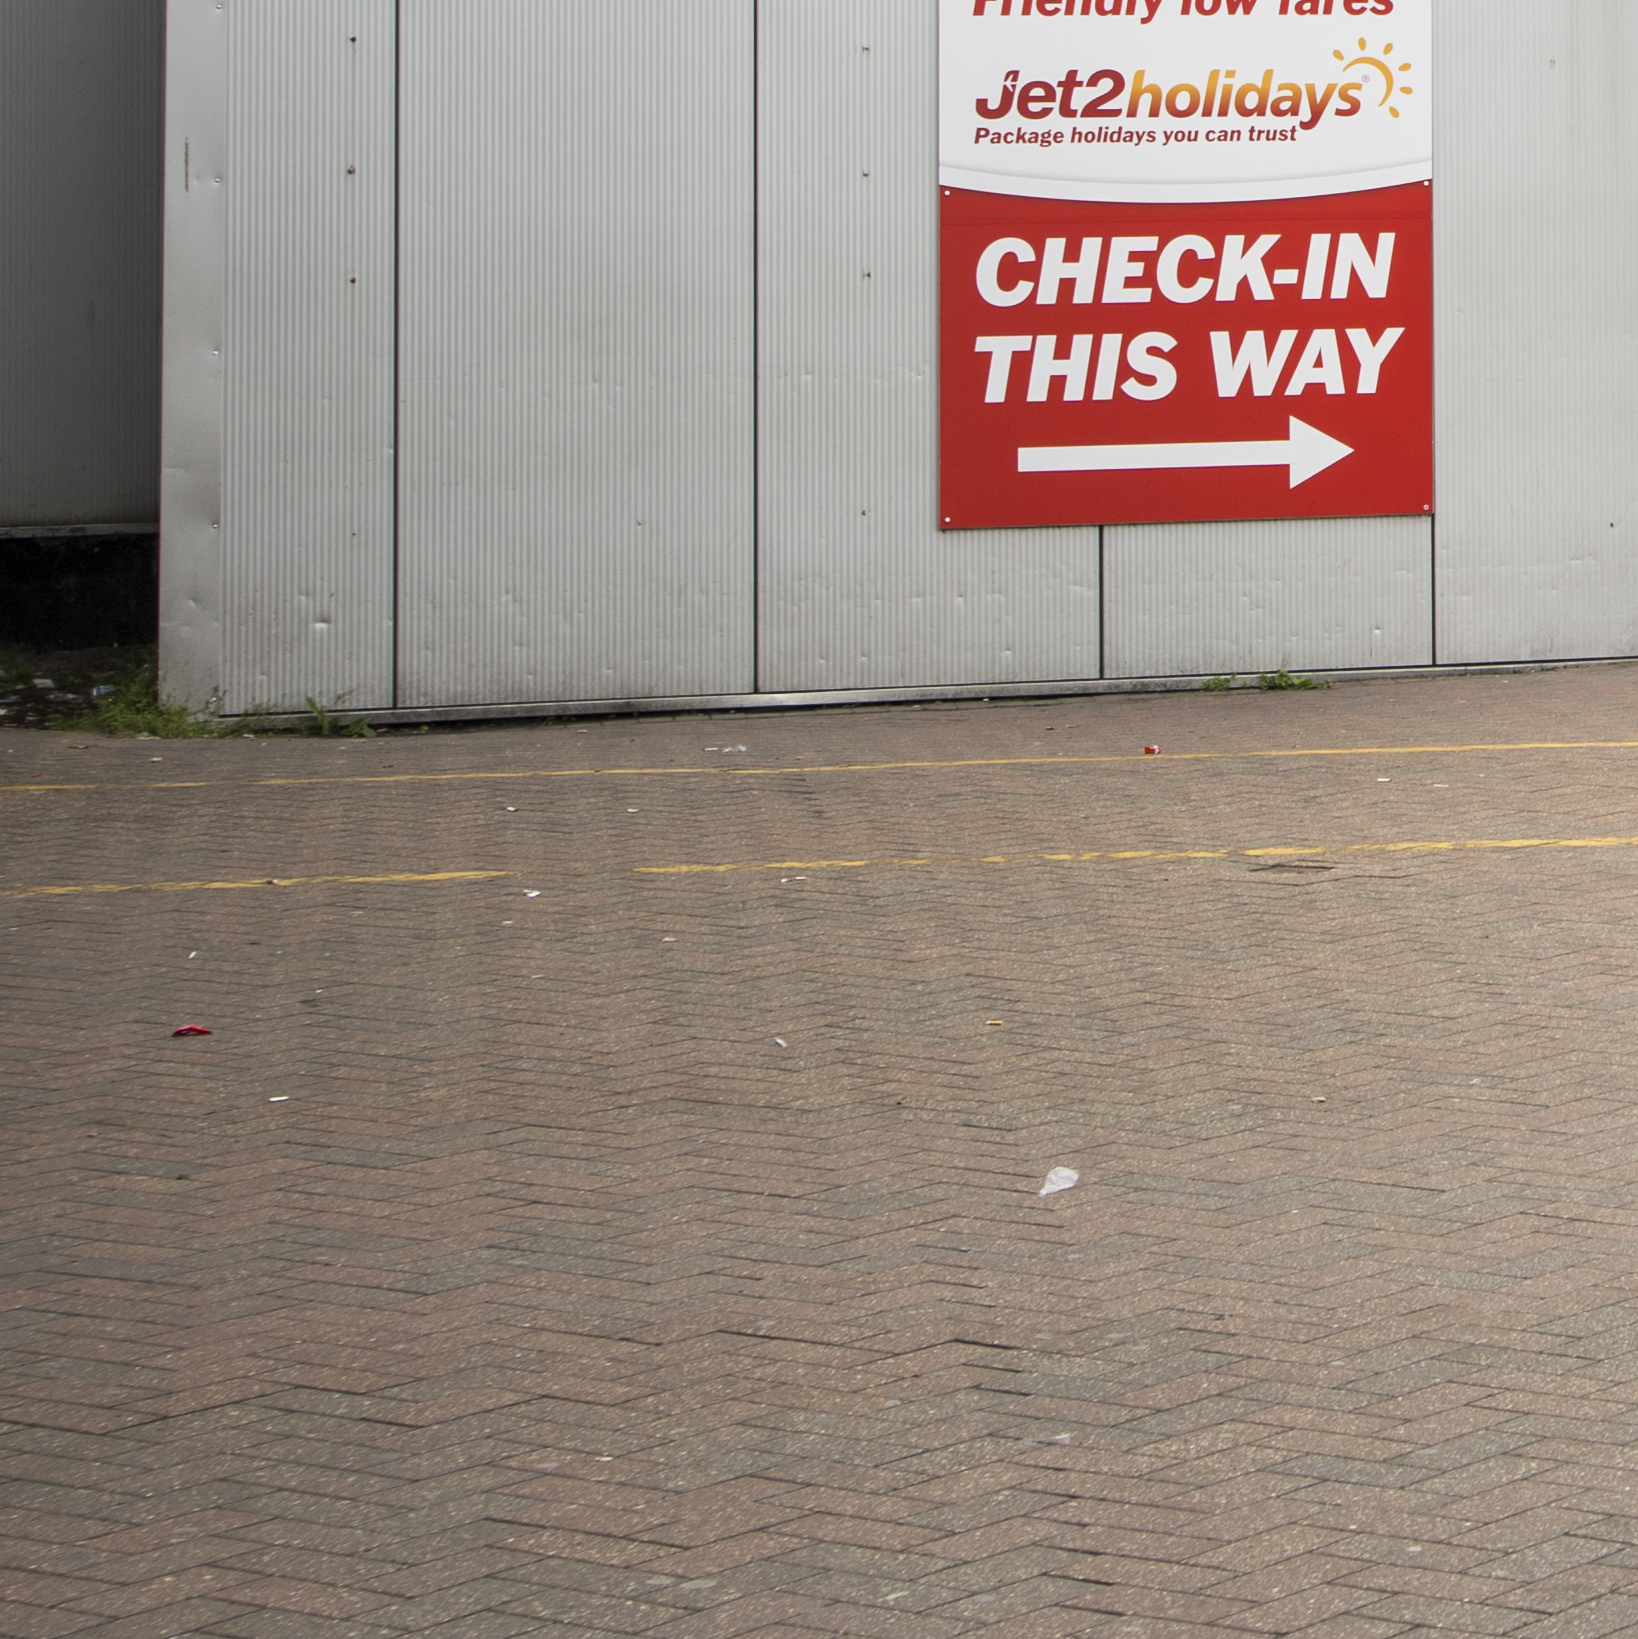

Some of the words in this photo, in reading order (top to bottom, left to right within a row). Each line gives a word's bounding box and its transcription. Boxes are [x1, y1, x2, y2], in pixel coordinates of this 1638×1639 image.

[975, 68, 1364, 130] Jet2holidays
[974, 127, 1064, 147] Package
[1070, 126, 1157, 146] holidays
[1162, 130, 1200, 145] you
[1204, 128, 1242, 143] can
[1248, 124, 1297, 143] trust
[976, 232, 1395, 307] CHECK-IN
[974, 330, 1179, 403] THIS
[1210, 327, 1405, 398] WAY
